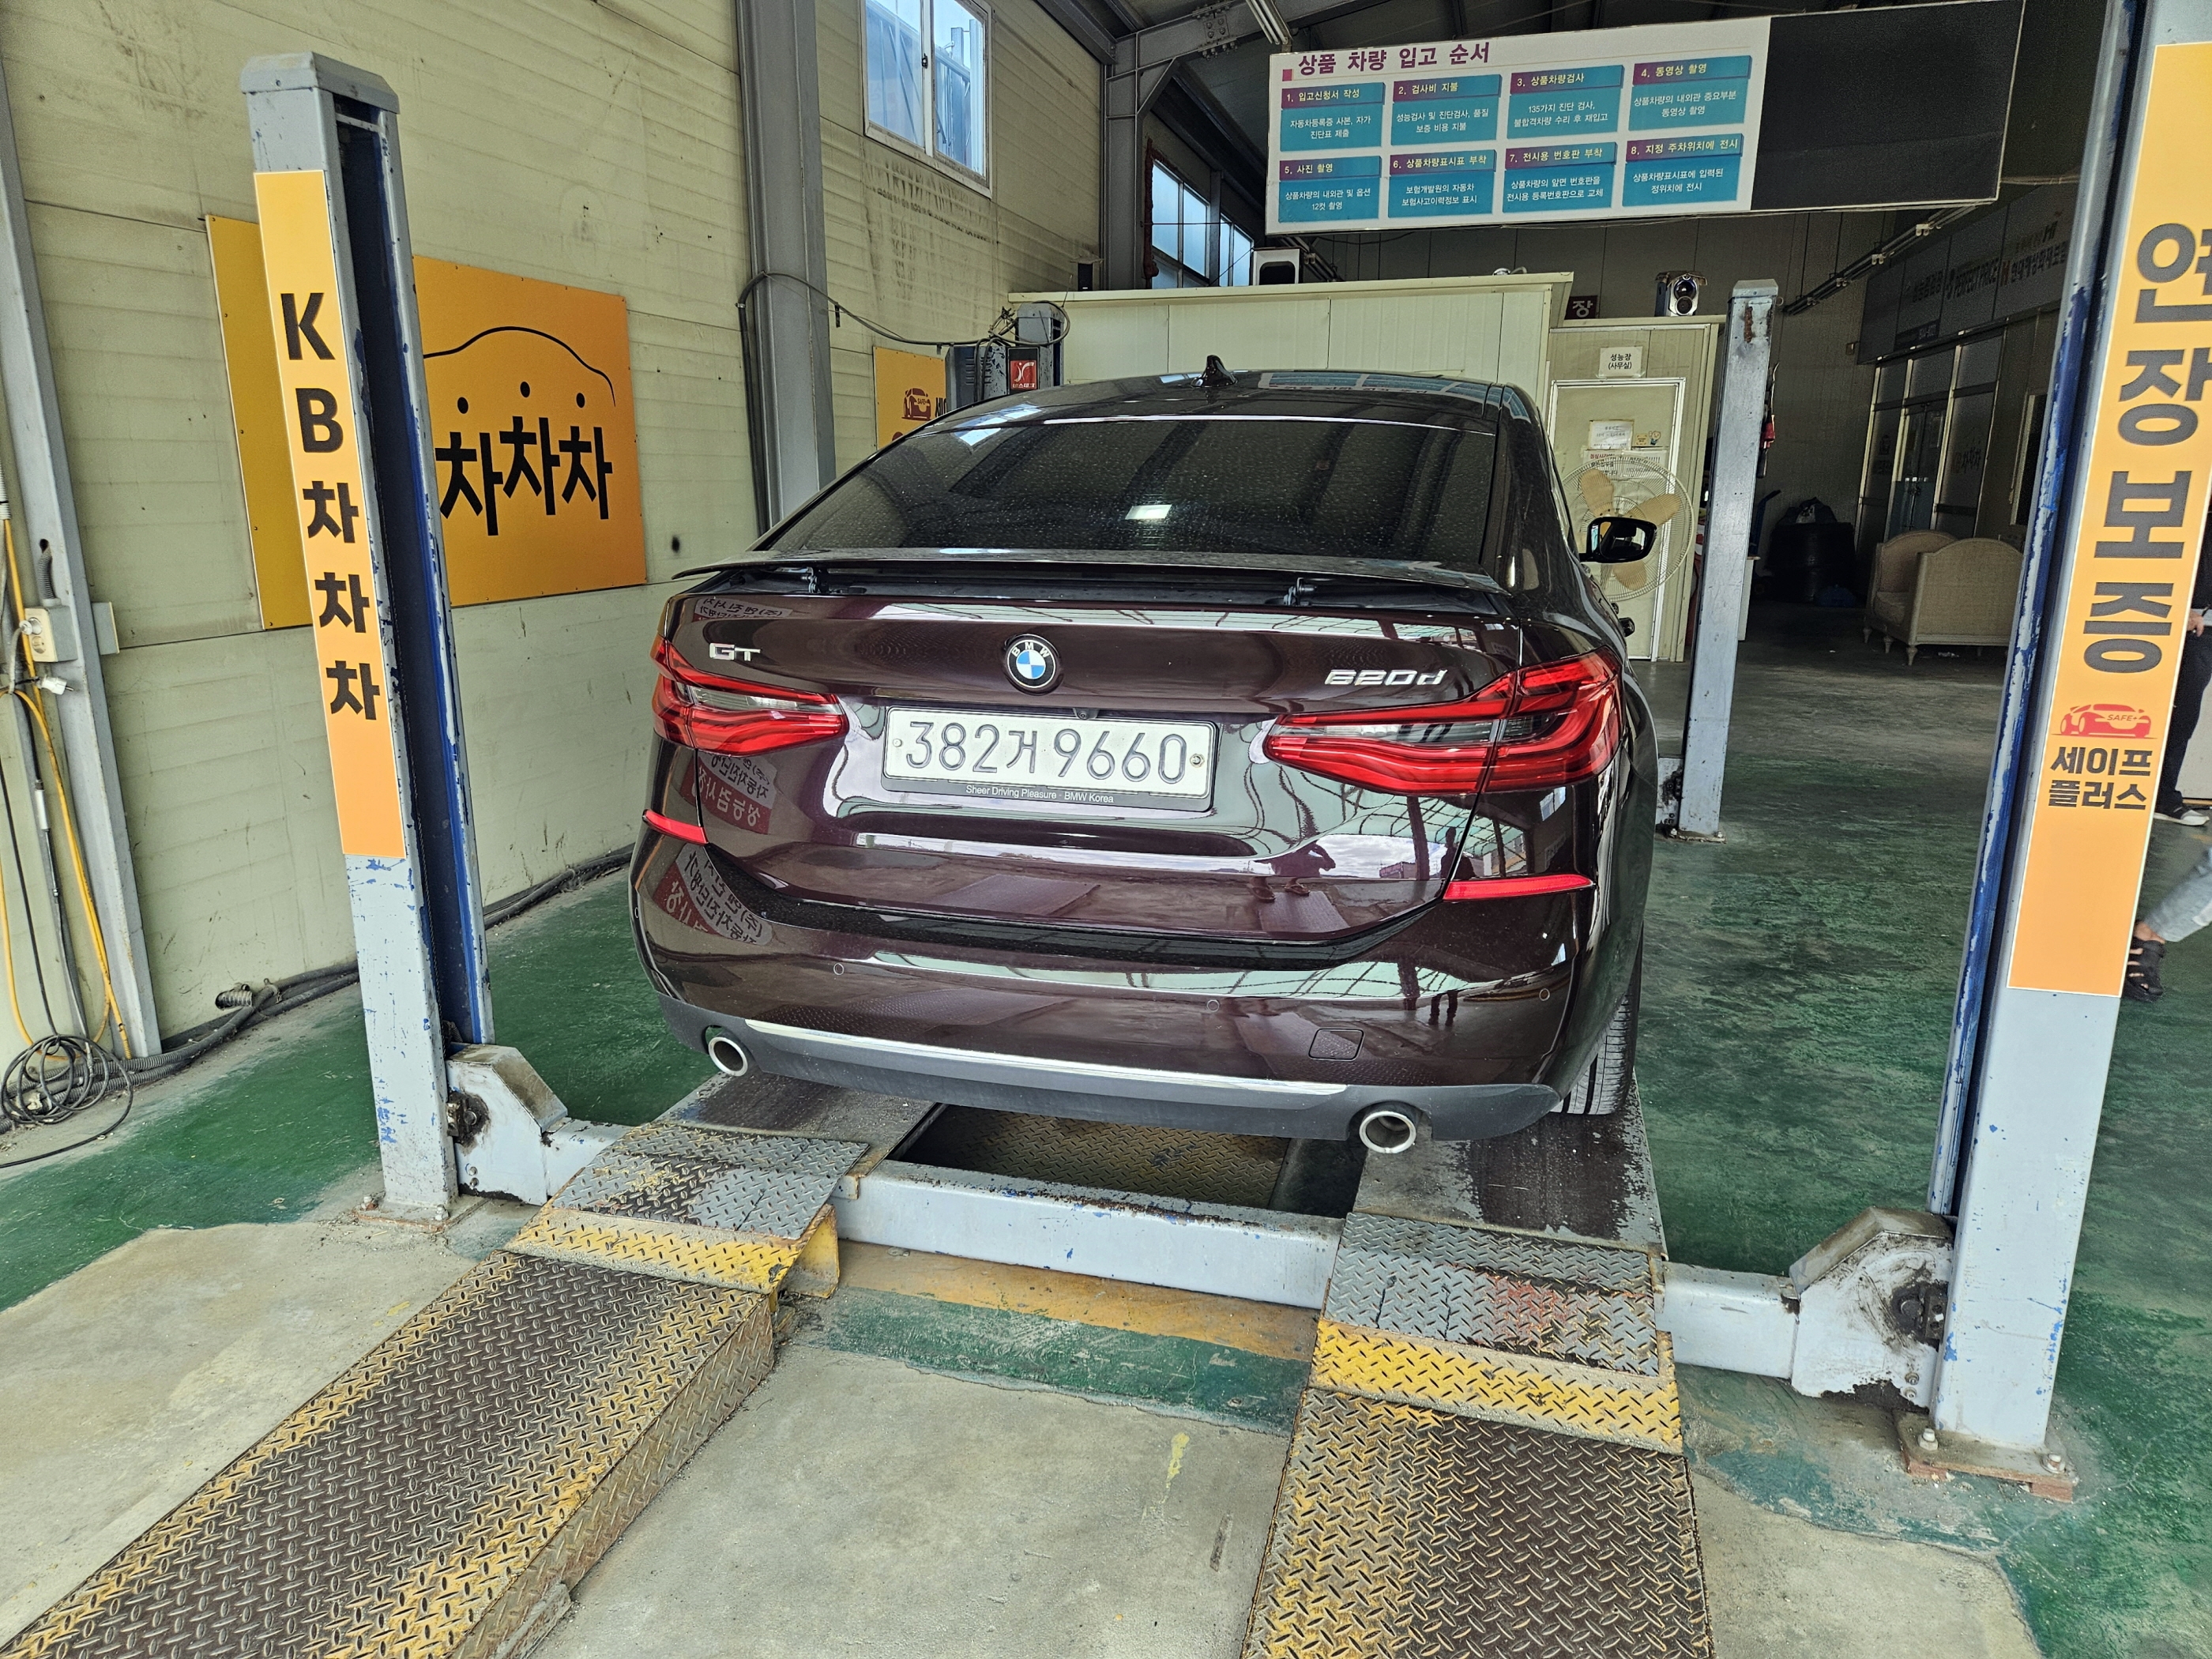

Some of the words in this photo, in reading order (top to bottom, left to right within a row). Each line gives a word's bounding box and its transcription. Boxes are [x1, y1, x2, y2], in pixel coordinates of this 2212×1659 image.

[1299, 54, 1336, 75] 상품
[1347, 50, 1386, 72] 차량
[1399, 47, 1437, 69] 입고
[1449, 42, 1490, 65] 순서
[1641, 69, 1650, 77] 4.
[1655, 66, 1683, 77] 동영상
[1688, 63, 1707, 75] 촬영
[1517, 78, 1525, 87] 3.
[1531, 73, 1584, 86] 상품차량검사
[1298, 89, 1339, 102] 입고신청서
[1344, 88, 1360, 99] 작성
[1398, 87, 1406, 96] 2.
[1412, 83, 1436, 94] 검사비
[1442, 82, 1458, 92] 지불
[1634, 96, 1673, 106] 상품차량의
[1677, 93, 1701, 103] 내외관
[1704, 91, 1736, 101] 중요부분
[1529, 103, 1556, 113] 135가지
[1559, 102, 1574, 111] 진단
[1578, 101, 1595, 111] 검사,
[1661, 107, 1686, 118] 동영상
[1689, 105, 1706, 115] 촬영
[1290, 118, 1334, 128] 자동차등록증
[1356, 115, 1371, 125] 자가
[1396, 113, 1425, 122] 성능검사
[1428, 111, 1435, 120] 및
[1439, 109, 1470, 120] 진단검사,
[1473, 108, 1489, 118] 품질
[1514, 116, 1552, 127] 불합격차량
[1555, 115, 1570, 125] 수리
[1574, 115, 1581, 123] 후
[1585, 113, 1608, 122] 재입고
[1310, 130, 1332, 139] 진단표
[1335, 128, 1349, 137] 제출
[1416, 123, 1431, 133] 보증
[1434, 122, 1449, 132] 비용
[1451, 122, 1466, 131] 지불
[1631, 147, 1639, 156] 8.
[1646, 144, 1664, 154] 지정
[1668, 141, 1714, 152] 주차위치에
[1720, 138, 1738, 149] 전시
[1393, 160, 1401, 169] 6.
[1406, 156, 1465, 168] 상품차량표시표
[1469, 155, 1487, 165] 부착
[1510, 154, 1518, 163] 7.
[1523, 151, 1548, 162] 전시용
[1554, 149, 1579, 160] 번호판
[1584, 148, 1602, 158] 부착
[1296, 164, 1313, 174] 사진
[1317, 163, 1334, 173] 촬영
[1633, 169, 1696, 182] 상품차량표시표에
[1699, 168, 1724, 179] 입력된
[1406, 184, 1449, 194] 보험개발원의
[1452, 182, 1474, 193] 자동차
[1511, 179, 1548, 190] 상품차량의
[1552, 178, 1567, 188] 앞면
[1570, 176, 1600, 186] 번호판을
[1651, 183, 1683, 194] 정위치에
[1686, 182, 1702, 192] 전시
[1285, 190, 1320, 201] 상품차량의
[1322, 189, 1344, 199] 내외관
[1347, 188, 1353, 198] 및
[1356, 187, 1371, 198] 옵션
[1401, 197, 1460, 207] 보험사고이력정보
[1462, 195, 1477, 205] 표시
[1507, 191, 1529, 201] 전시용
[1532, 190, 1584, 201] 등록번호판으로
[1587, 188, 1603, 198] 교체
[1312, 202, 1326, 211] 12컷
[1328, 201, 1343, 210] 촬영
[1610, 352, 1631, 361] 성능장
[1608, 361, 1632, 370] (사무실)
[435, 416, 613, 536] 차차차
[709, 642, 762, 662] GT
[1010, 640, 1051, 658] BMW
[1325, 669, 1447, 687] 620d
[2050, 746, 2152, 777] 세이프
[966, 784, 990, 795] Sheer
[992, 787, 1019, 799] Driving
[1021, 788, 1057, 799] Pleasure
[1064, 792, 1087, 801] BMW
[1089, 793, 1114, 803] Korea
[2048, 779, 2146, 811] 플러스
